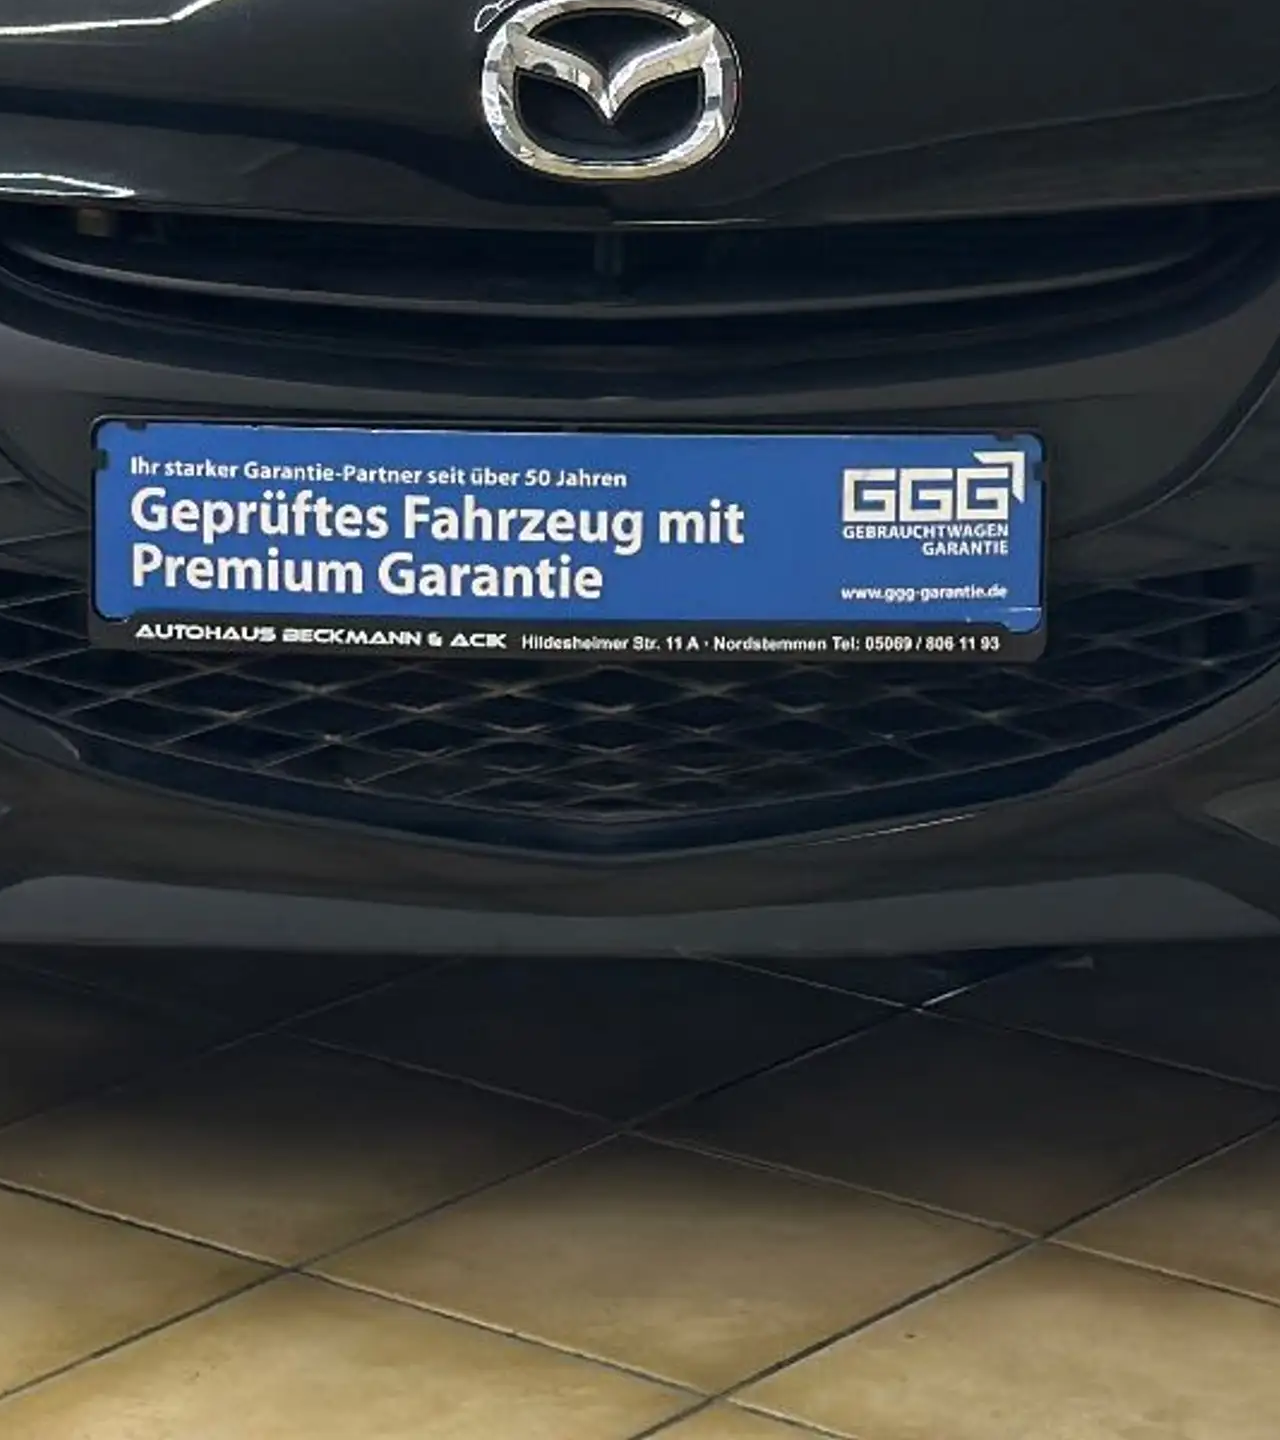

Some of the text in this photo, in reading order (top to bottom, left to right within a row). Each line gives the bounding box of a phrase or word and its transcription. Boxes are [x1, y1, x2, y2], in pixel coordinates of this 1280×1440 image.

[131, 456, 627, 488] Ihr starker Garantie-Partner seit über 50 Jahren
[842, 467, 1009, 522] GGG
[131, 487, 745, 554] Geprüftes Fahrzeug mit
[842, 523, 1009, 539] GEBRAUCHTWAGEN
[921, 540, 1009, 556] GARANTIE
[133, 543, 603, 599] Premium Garantie
[841, 584, 1008, 603] www.ggg-garantie.de
[134, 624, 277, 643] AUTOHAUS
[282, 628, 422, 647] BECKMANN
[427, 631, 443, 648] &
[521, 634, 630, 651] Hildesheimer
[632, 635, 662, 651] Str.
[713, 635, 828, 652] Nordstemmen
[831, 635, 861, 652] Tel:
[865, 635, 913, 652] 05069
[925, 635, 955, 652] 806
[959, 636, 976, 652] 11
